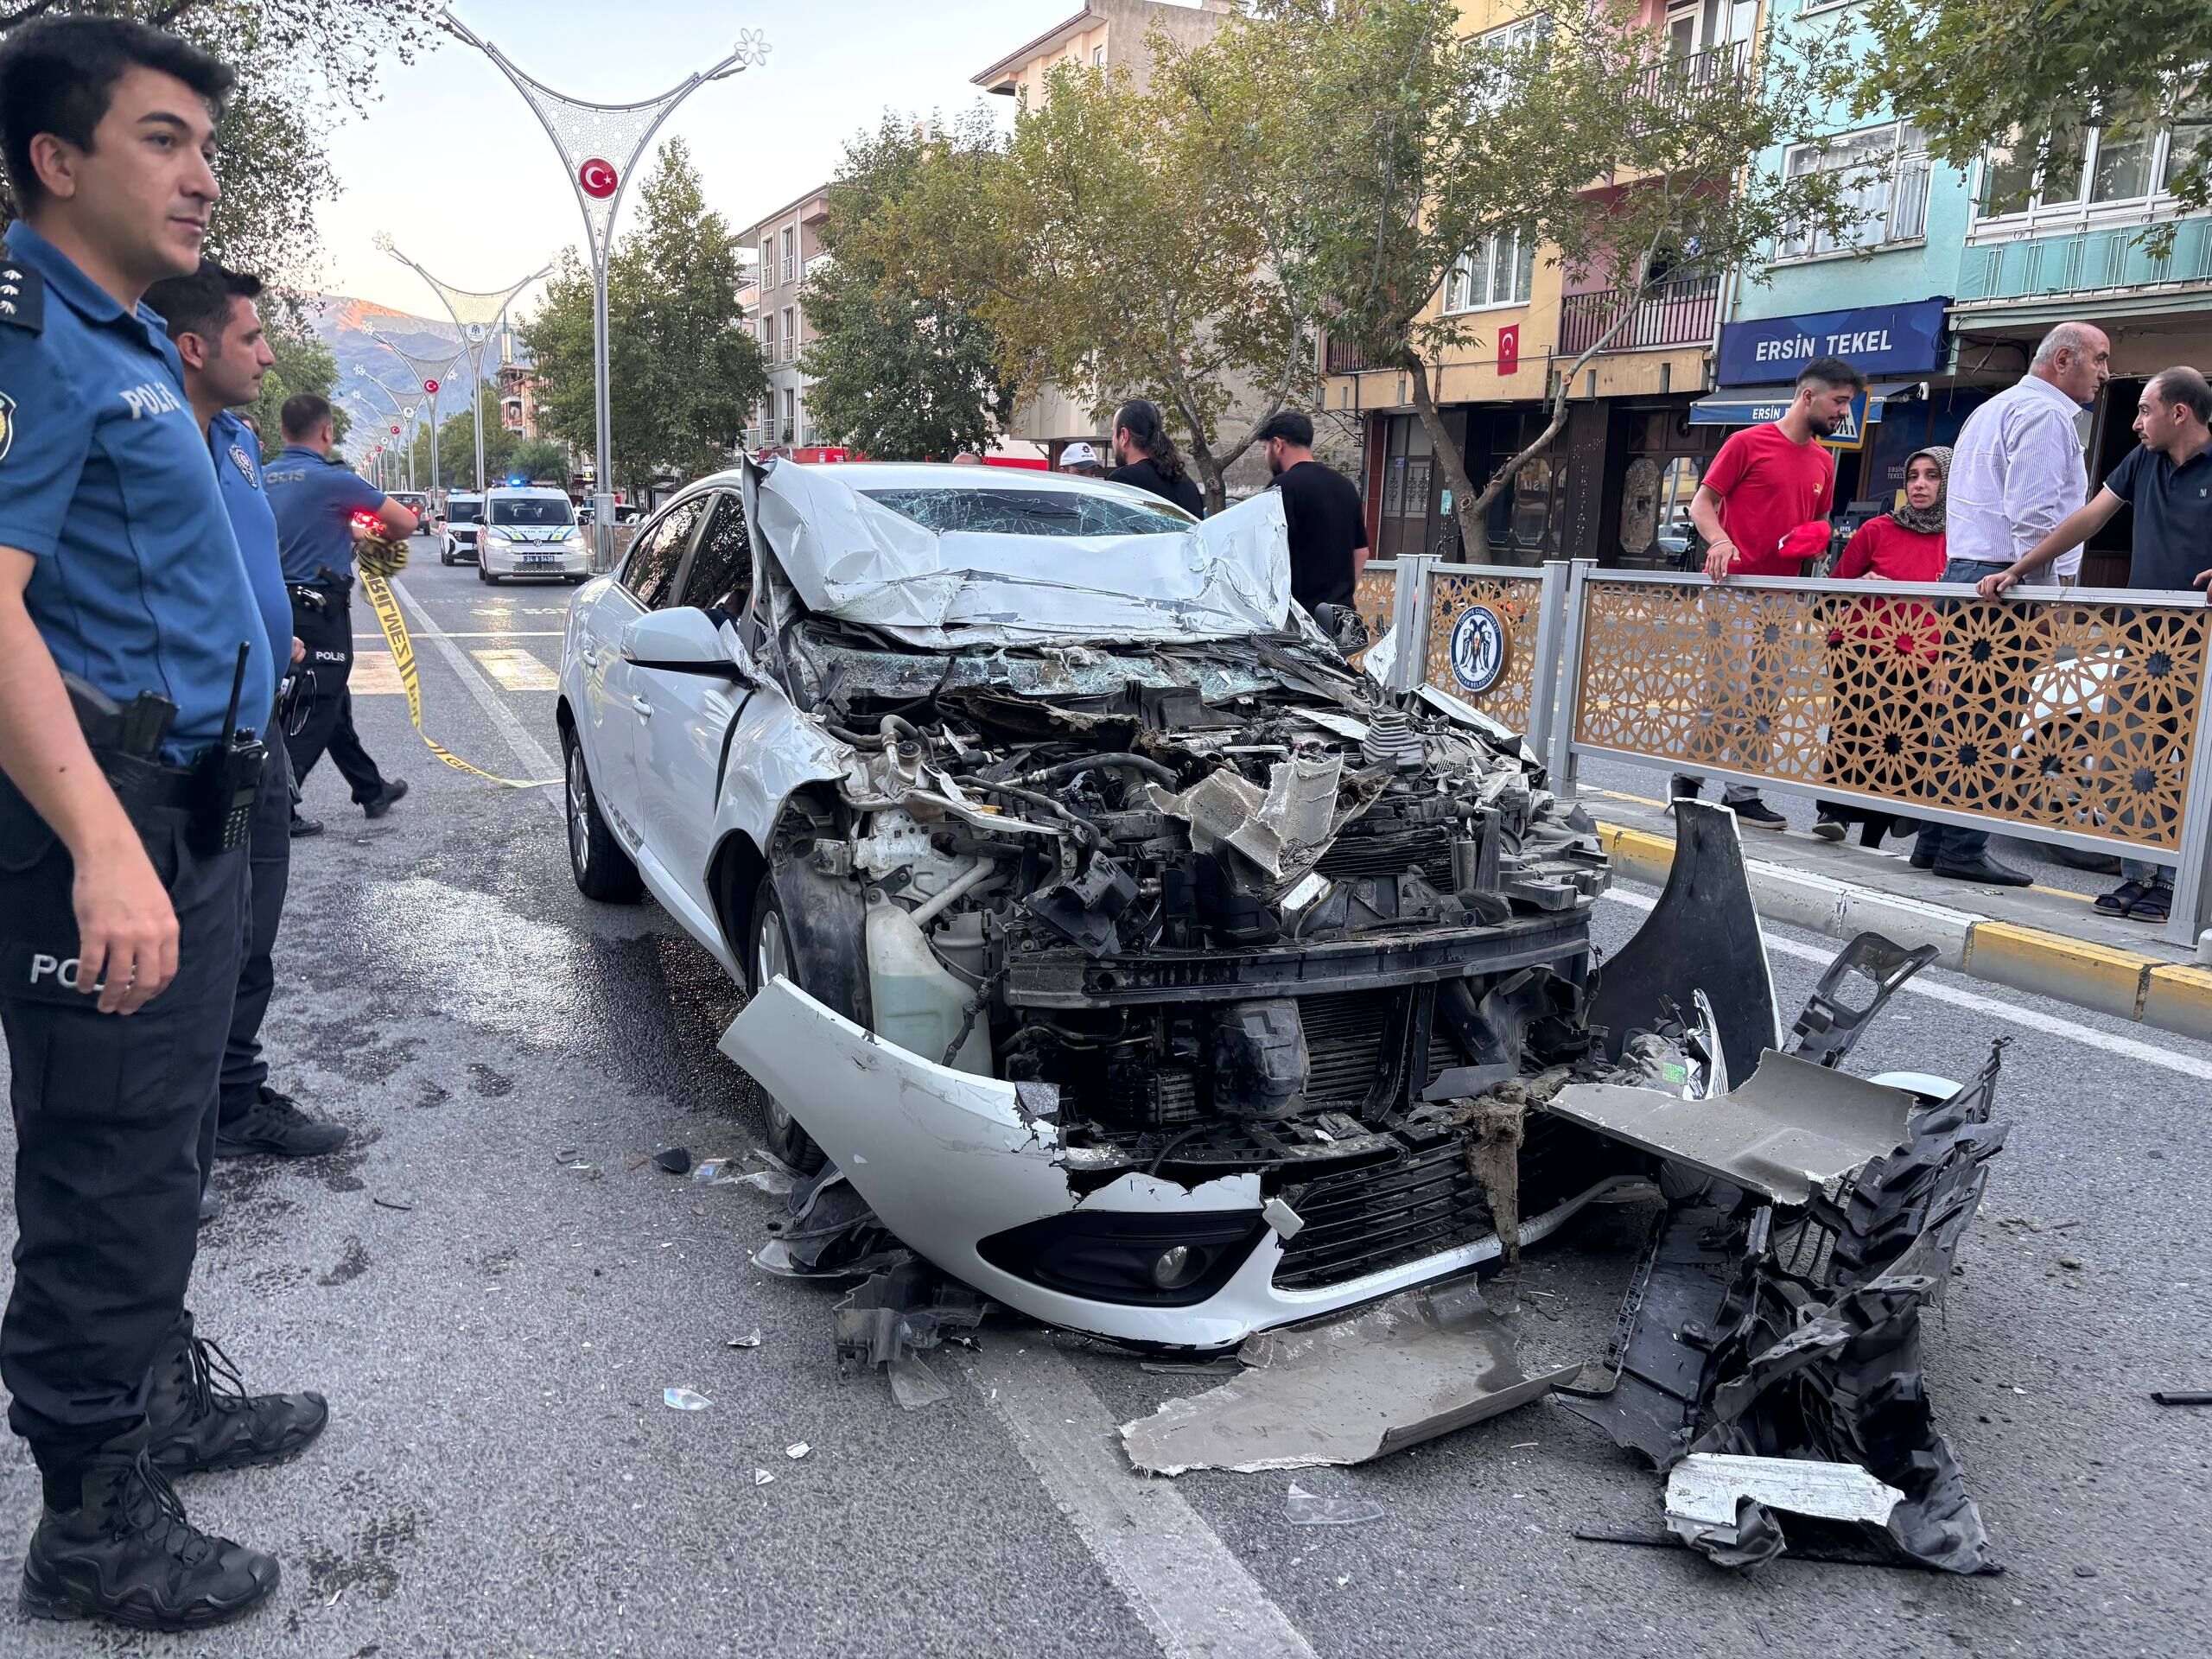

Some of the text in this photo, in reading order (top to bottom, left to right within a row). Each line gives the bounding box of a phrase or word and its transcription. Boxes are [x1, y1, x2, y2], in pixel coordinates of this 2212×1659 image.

[1755, 329, 1892, 361] ERSİN TEKEL
[1752, 405, 1781, 420] ERSİN
